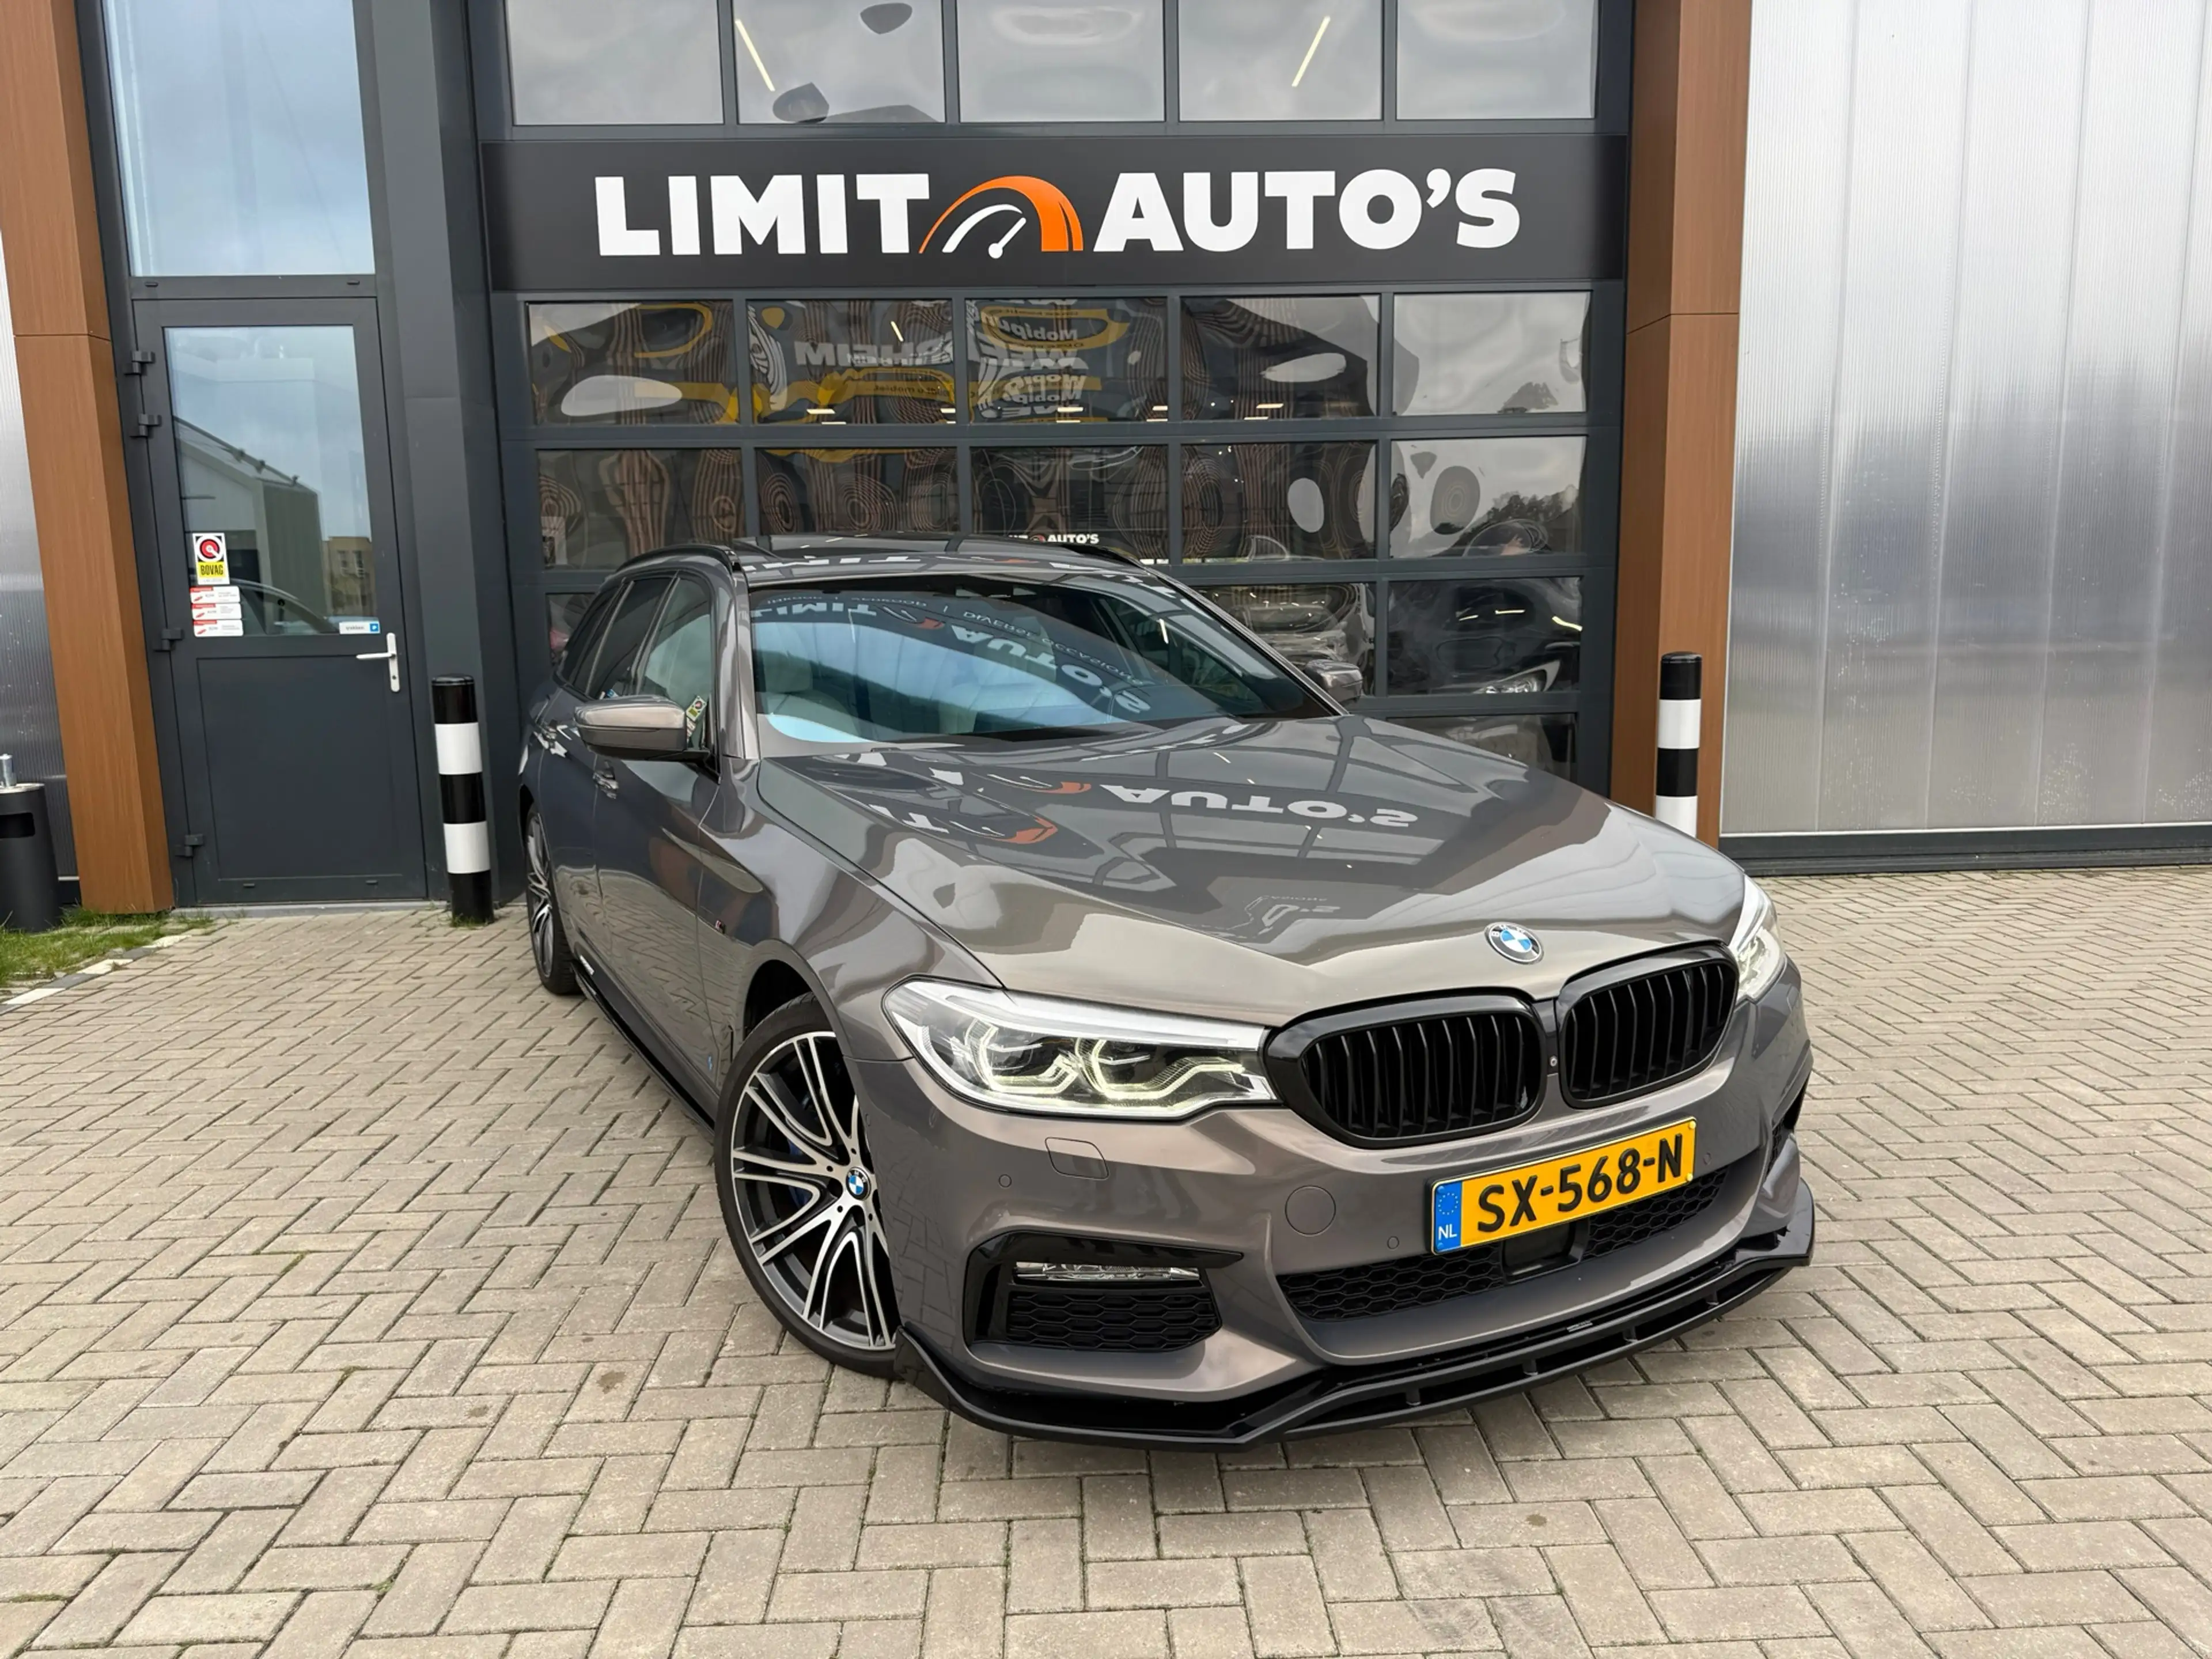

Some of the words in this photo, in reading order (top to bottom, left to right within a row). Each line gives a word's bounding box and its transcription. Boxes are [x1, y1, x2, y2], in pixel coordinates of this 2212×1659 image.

[594, 173, 930, 255] LIMIT
[1093, 168, 1521, 252] AUTO'S
[1047, 533, 1099, 544] AUTO'S
[200, 565, 224, 576] BOVAG
[1477, 1133, 1683, 1232] SX-568-N
[1438, 1224, 1457, 1239] NL
